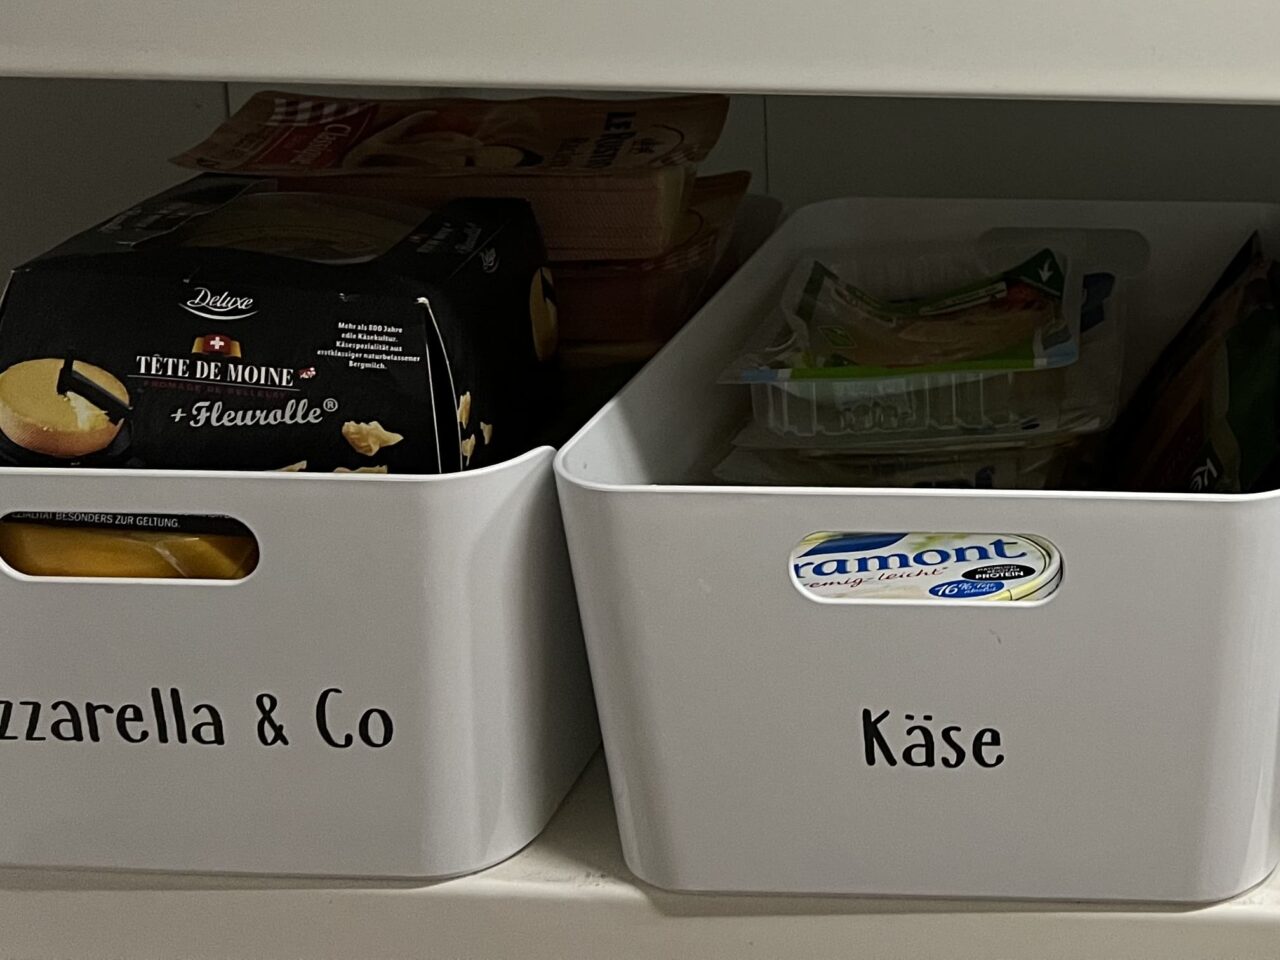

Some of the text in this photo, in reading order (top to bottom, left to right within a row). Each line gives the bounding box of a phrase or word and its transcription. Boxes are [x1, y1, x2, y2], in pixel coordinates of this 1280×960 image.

[186, 287, 254, 311] Deluxe
[338, 322, 356, 330] Mehr
[383, 325, 403, 333] Jahre
[136, 353, 294, 387] TÊTE DE MOINE
[55, 513, 181, 529] BESONDERS ZUR GELTUNG.
[794, 538, 1028, 579] ramont
[975, 571, 1025, 579] PROTEIN
[256, 694, 289, 746] &
[316, 688, 393, 748] Co
[863, 708, 1004, 768] Käse
